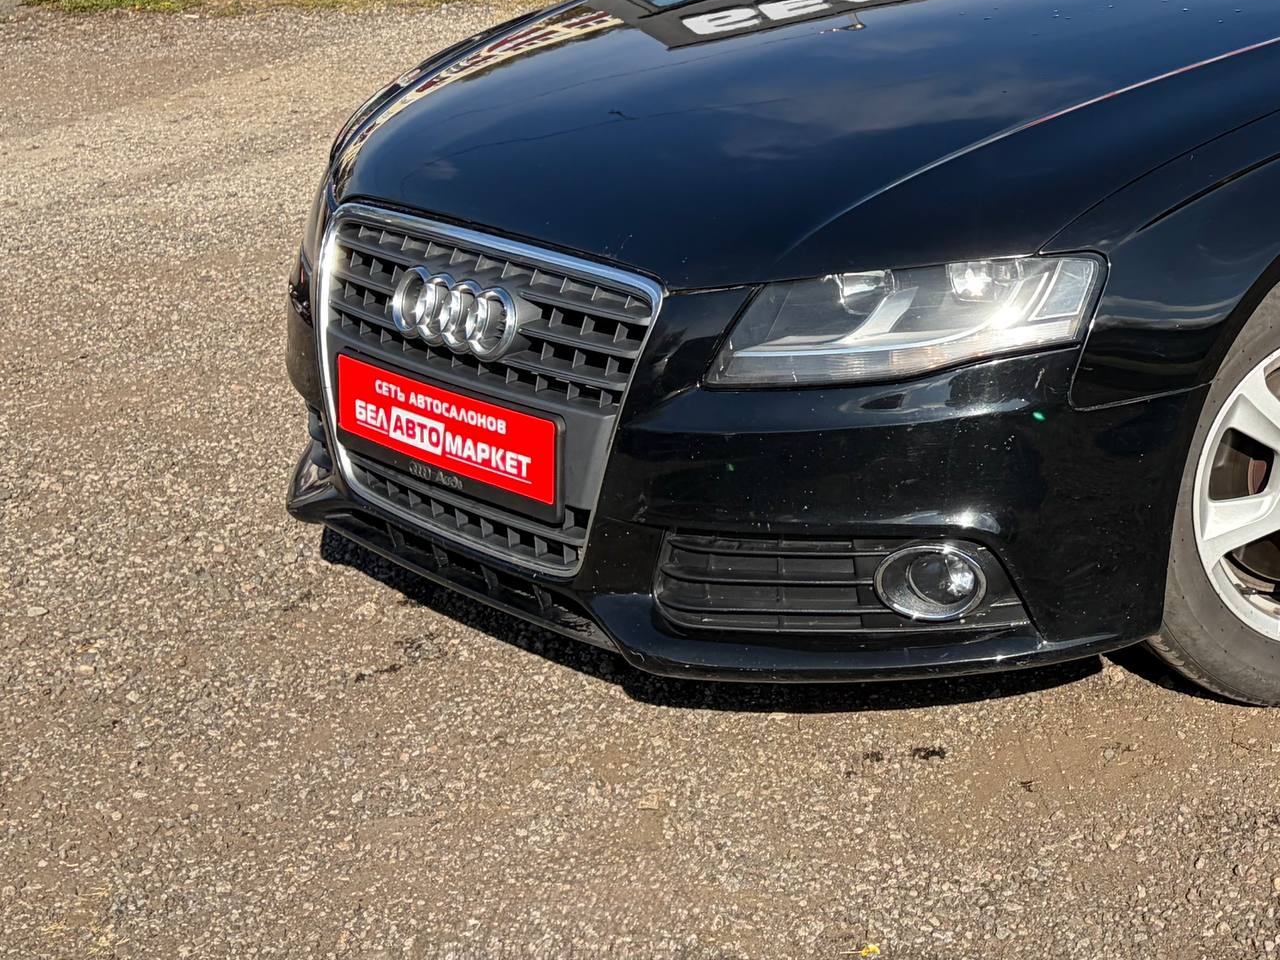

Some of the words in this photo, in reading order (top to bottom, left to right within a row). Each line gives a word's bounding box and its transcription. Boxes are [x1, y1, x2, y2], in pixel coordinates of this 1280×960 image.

[355, 398, 388, 431] БЕЛ
[392, 414, 441, 449] АВТО
[445, 431, 532, 478] МАРКЕТ
[374, 379, 406, 402] СЕТЬ
[408, 391, 507, 435] АВТОСАЛОНОВ
